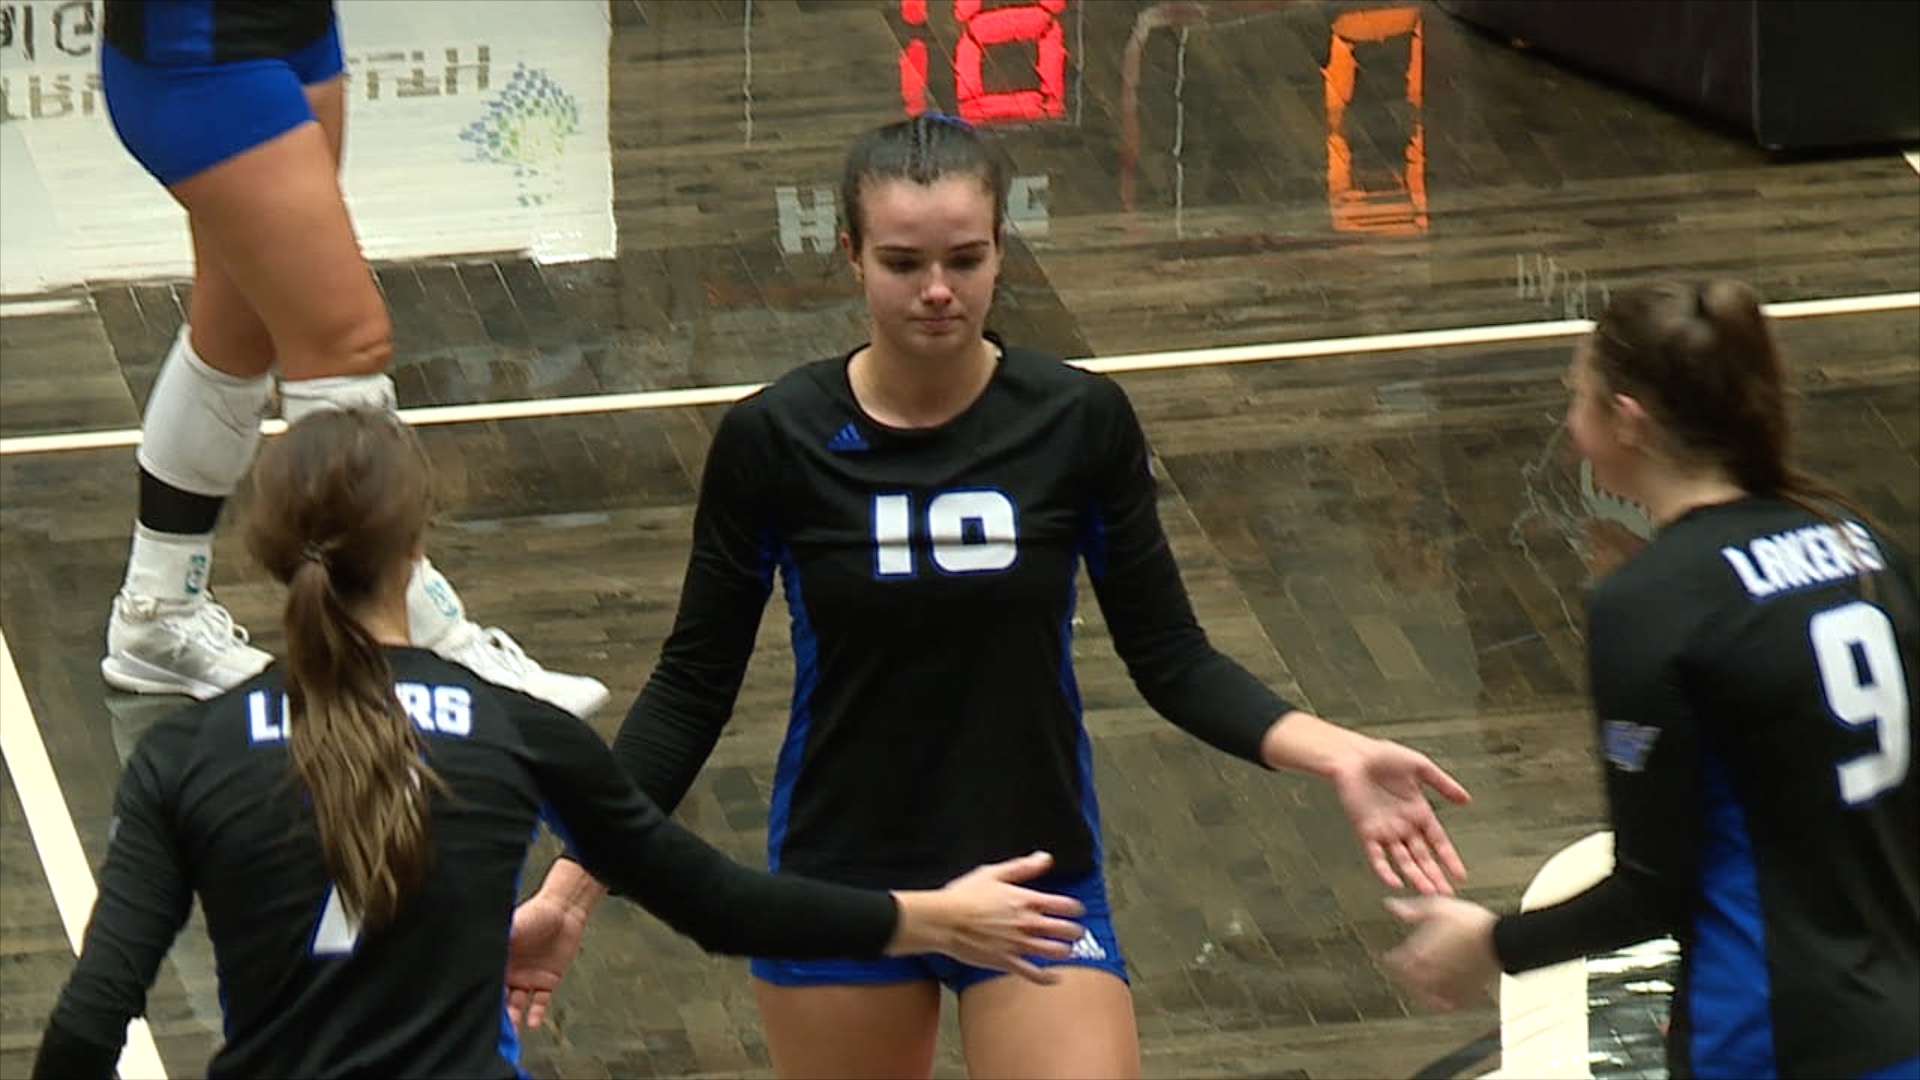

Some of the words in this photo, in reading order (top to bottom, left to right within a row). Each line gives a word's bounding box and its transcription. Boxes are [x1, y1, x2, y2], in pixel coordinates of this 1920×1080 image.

[870, 487, 1020, 578] 10
[246, 681, 472, 743] LRS
[1807, 599, 1911, 806] 9
